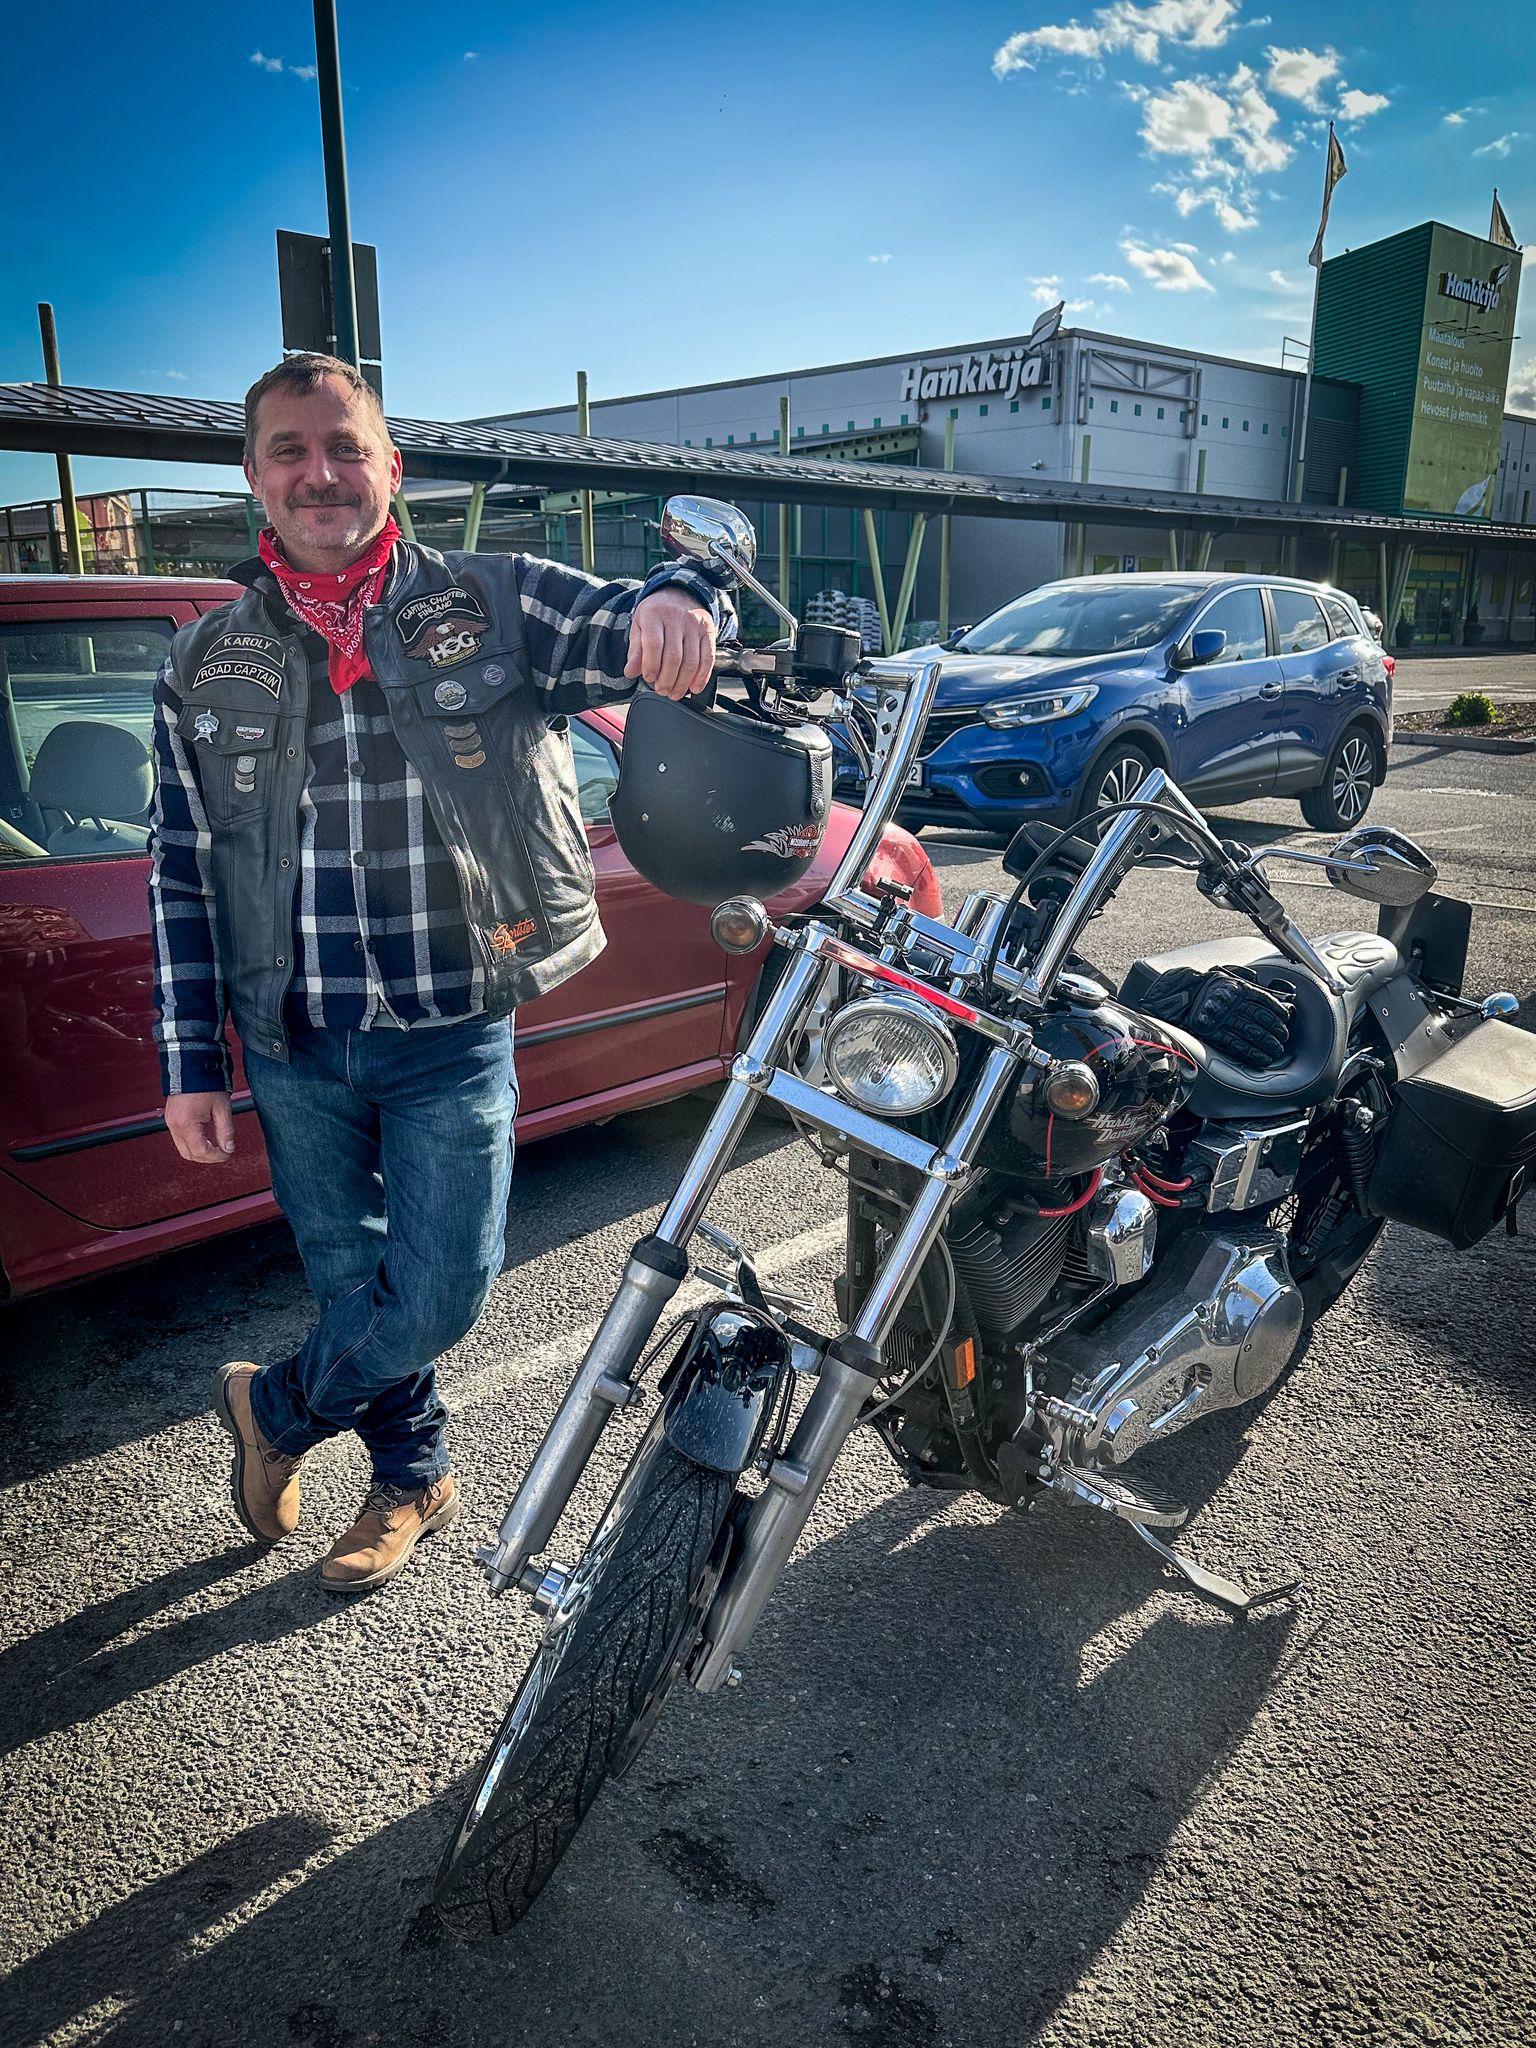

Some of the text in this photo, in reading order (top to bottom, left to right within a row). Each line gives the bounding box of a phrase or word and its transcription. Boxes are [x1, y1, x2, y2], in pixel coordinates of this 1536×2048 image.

[1446, 271, 1500, 314] Hankkija
[1428, 327, 1465, 349] Maatalous
[900, 349, 1043, 401] Hankkija
[1426, 351, 1484, 378] Koneet ja huolto
[1423, 375, 1500, 405] Puutarha ja vapaa-aika
[1421, 399, 1488, 426] Hevoset ja lemmikit
[402, 590, 467, 620] CAPITAL CHAPTER
[417, 600, 452, 620] FINLAND
[223, 637, 273, 650] KAROLY
[428, 630, 476, 664] HOG
[200, 664, 279, 688] ROAD CAPTAIN
[1087, 1113, 1138, 1130] Harley
